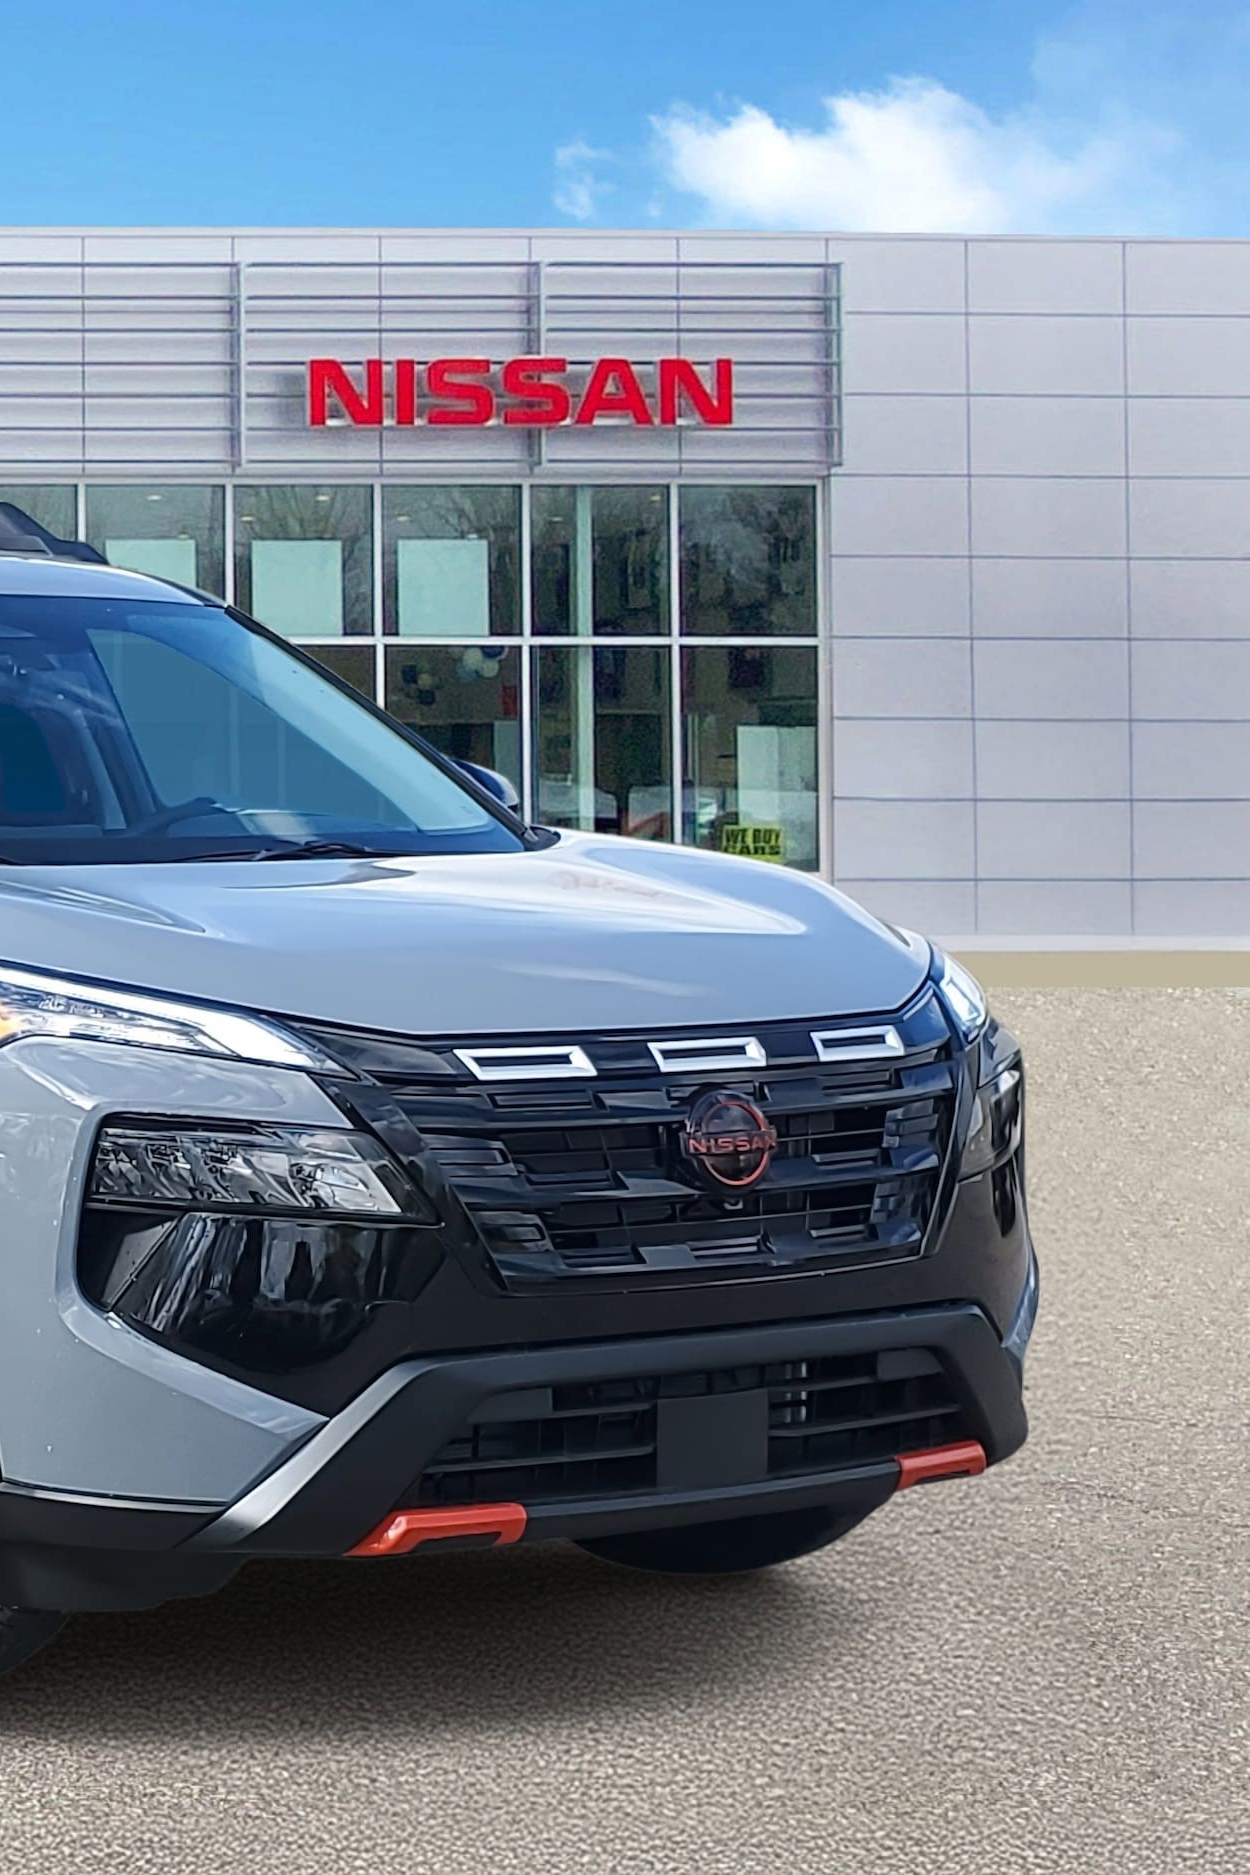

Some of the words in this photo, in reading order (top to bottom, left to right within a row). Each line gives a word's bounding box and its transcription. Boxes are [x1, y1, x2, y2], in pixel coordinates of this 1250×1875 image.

[307, 357, 733, 427] NISSAN
[724, 828, 748, 844] WE
[752, 828, 781, 844] BUY
[688, 1135, 776, 1154] NISSAN
